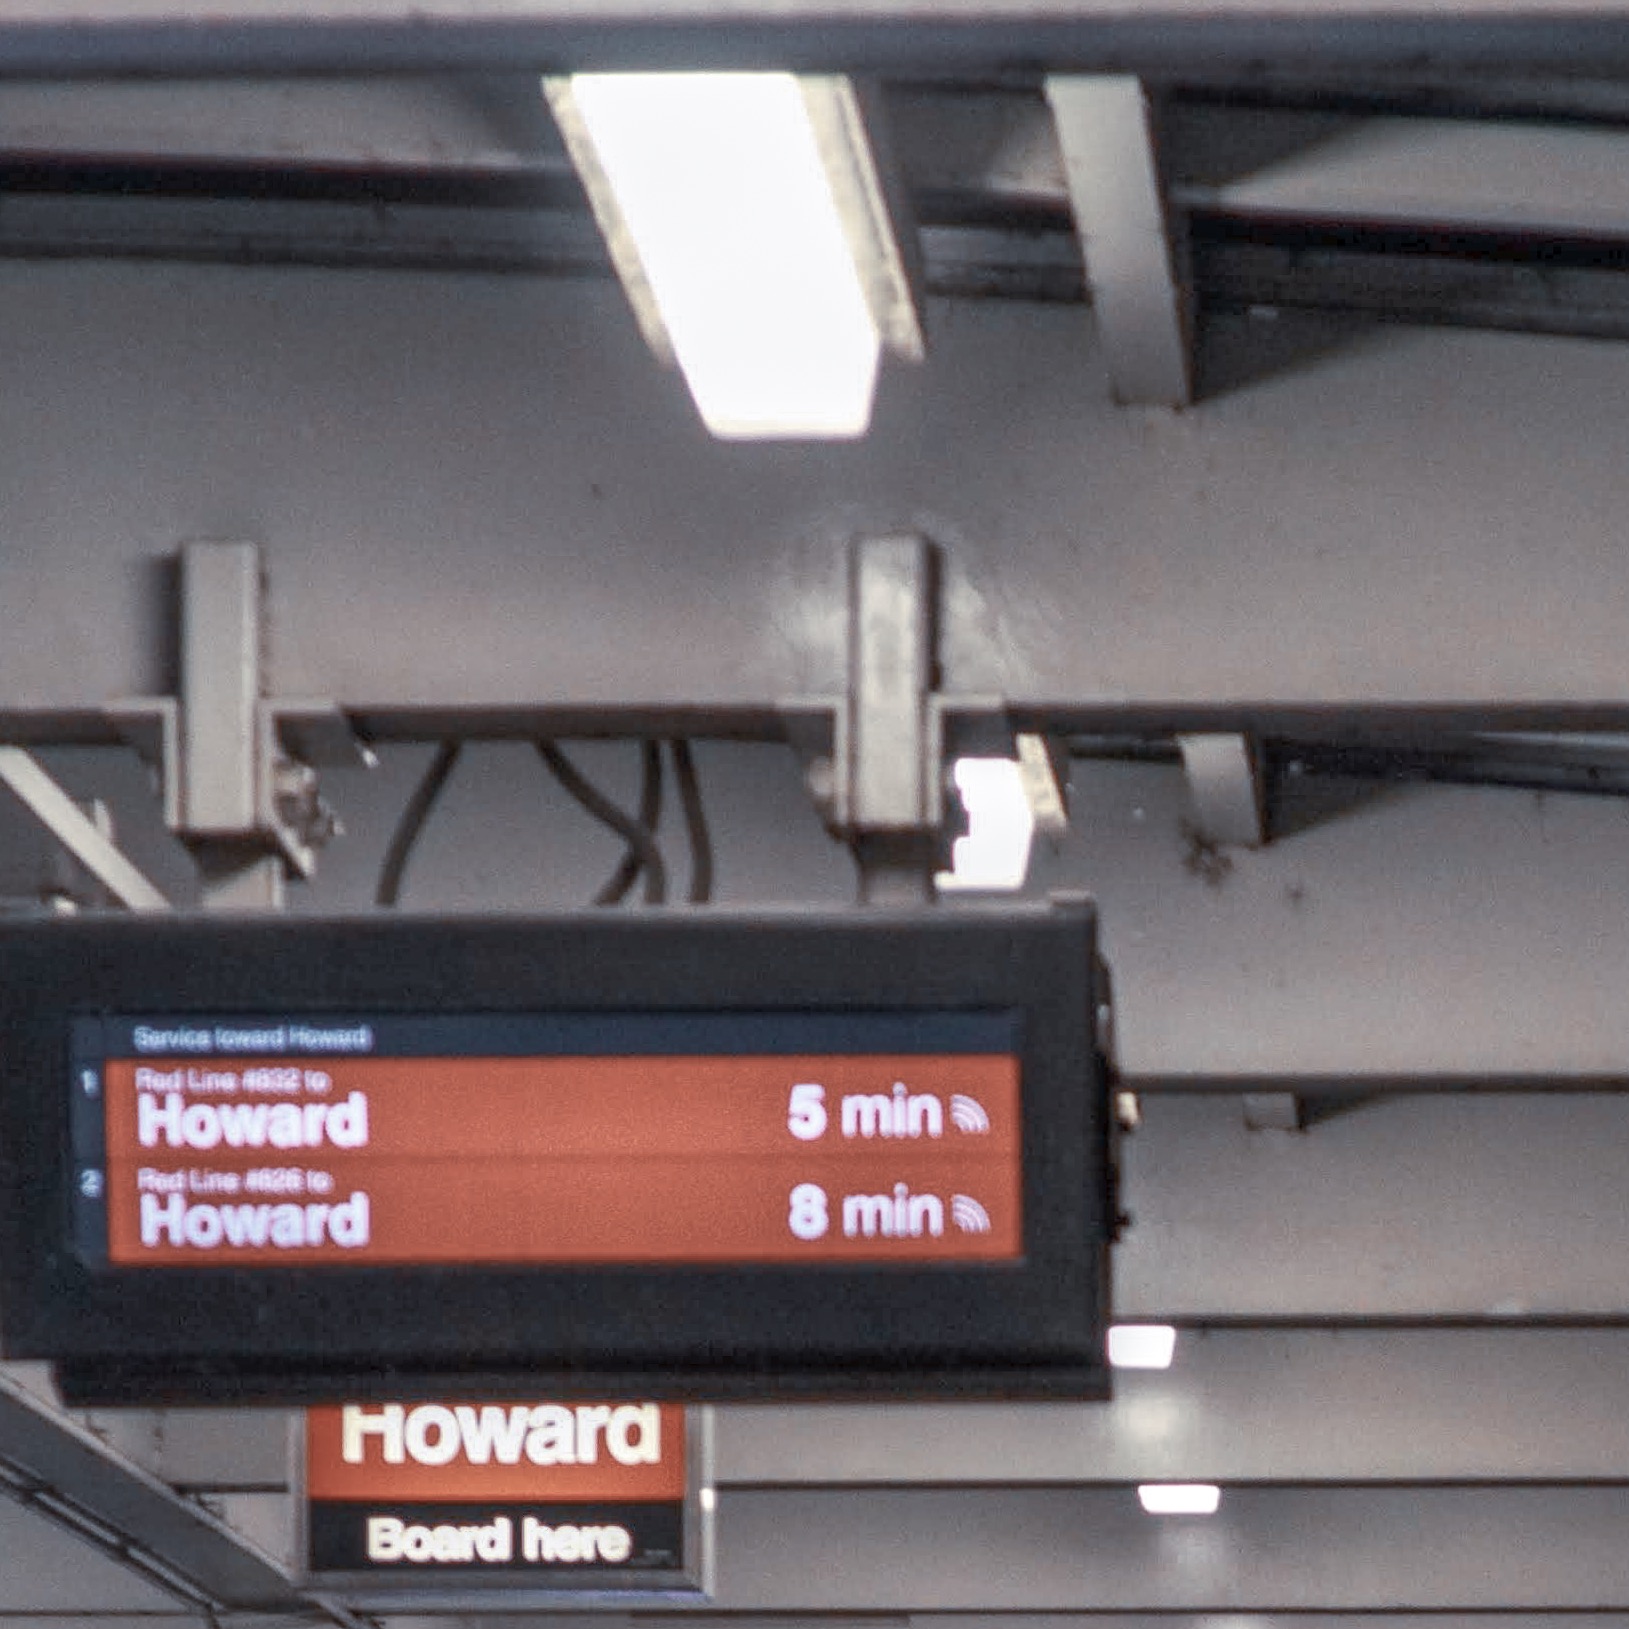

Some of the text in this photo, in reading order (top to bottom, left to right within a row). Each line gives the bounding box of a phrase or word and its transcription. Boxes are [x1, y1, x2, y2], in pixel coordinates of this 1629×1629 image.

[134, 1025, 374, 1053] Service toward Howard
[135, 1067, 184, 1094] Red
[187, 1067, 240, 1094] Line
[304, 1069, 331, 1093] to
[137, 1090, 369, 1148] Howard
[788, 1081, 944, 1140] 5 min
[80, 1168, 103, 1198] 2
[137, 1167, 186, 1193] Red
[189, 1167, 242, 1194] Line
[308, 1169, 333, 1194] to
[140, 1191, 371, 1248] Howard
[789, 1181, 945, 1240] 8 min
[341, 1402, 662, 1465] Howard
[365, 1516, 633, 1563] Board here
